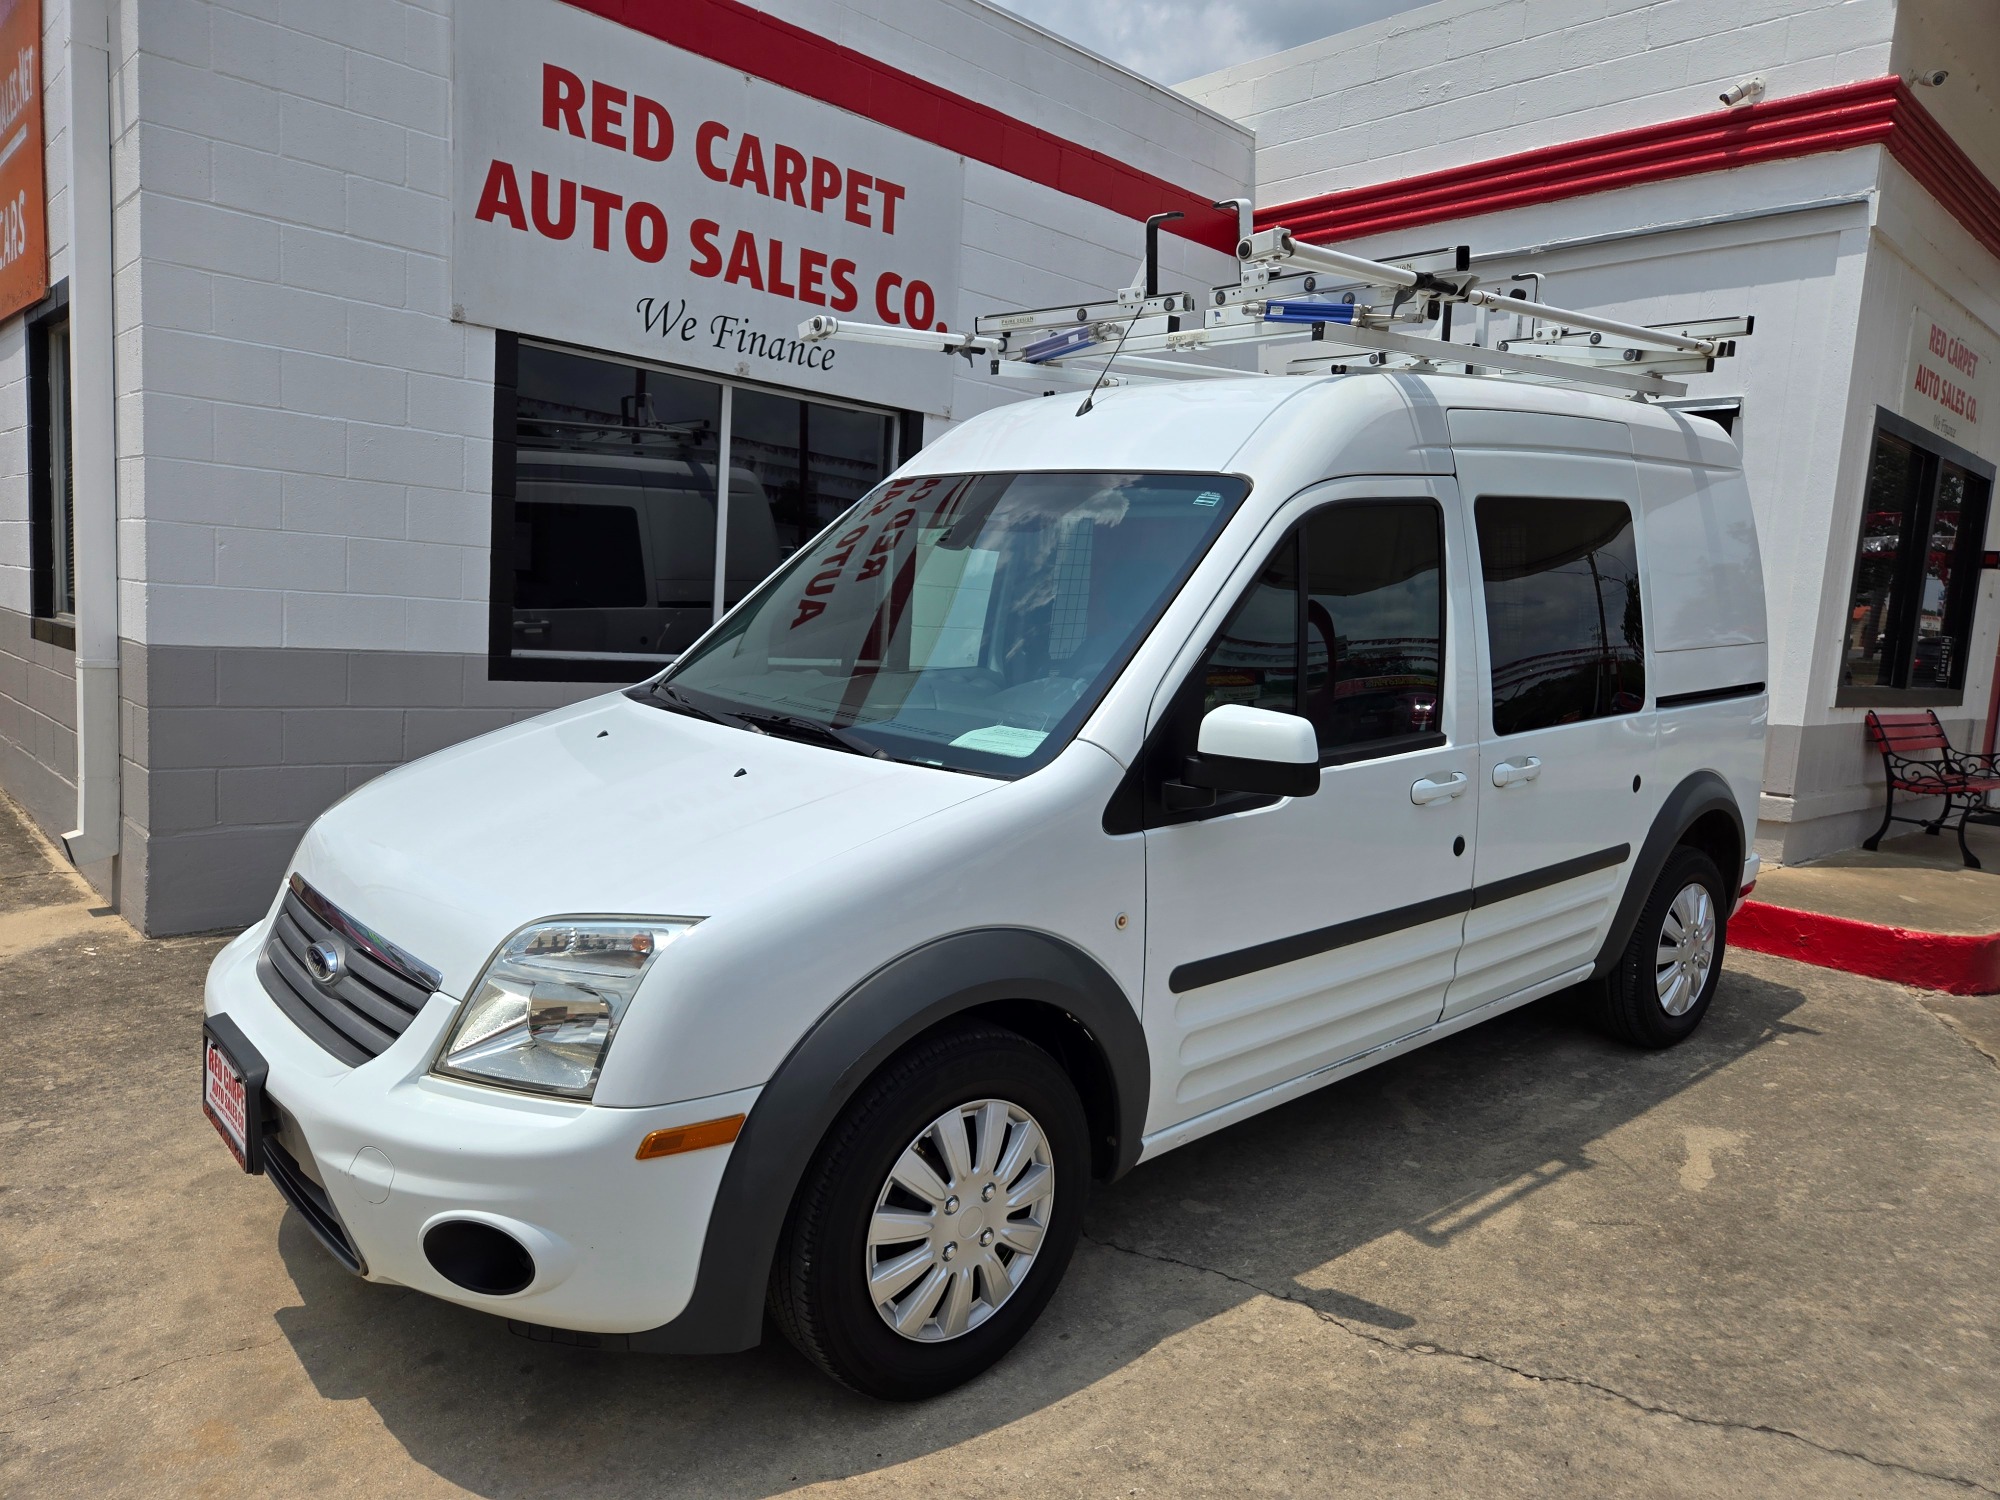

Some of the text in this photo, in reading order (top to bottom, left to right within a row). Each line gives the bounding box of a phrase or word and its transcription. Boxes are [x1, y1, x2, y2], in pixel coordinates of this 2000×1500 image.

[0, 45, 33, 137] ALES.NET
[543, 63, 905, 235] RED CARPET
[475, 160, 947, 332] AUTO SALES CO.
[636, 297, 835, 371] We Finance
[1928, 323, 1979, 379] RED CARPET
[1914, 364, 1978, 424] AUTO SALES CO.
[208, 1047, 223, 1083] RED
[223, 1064, 245, 1114] CARPE
